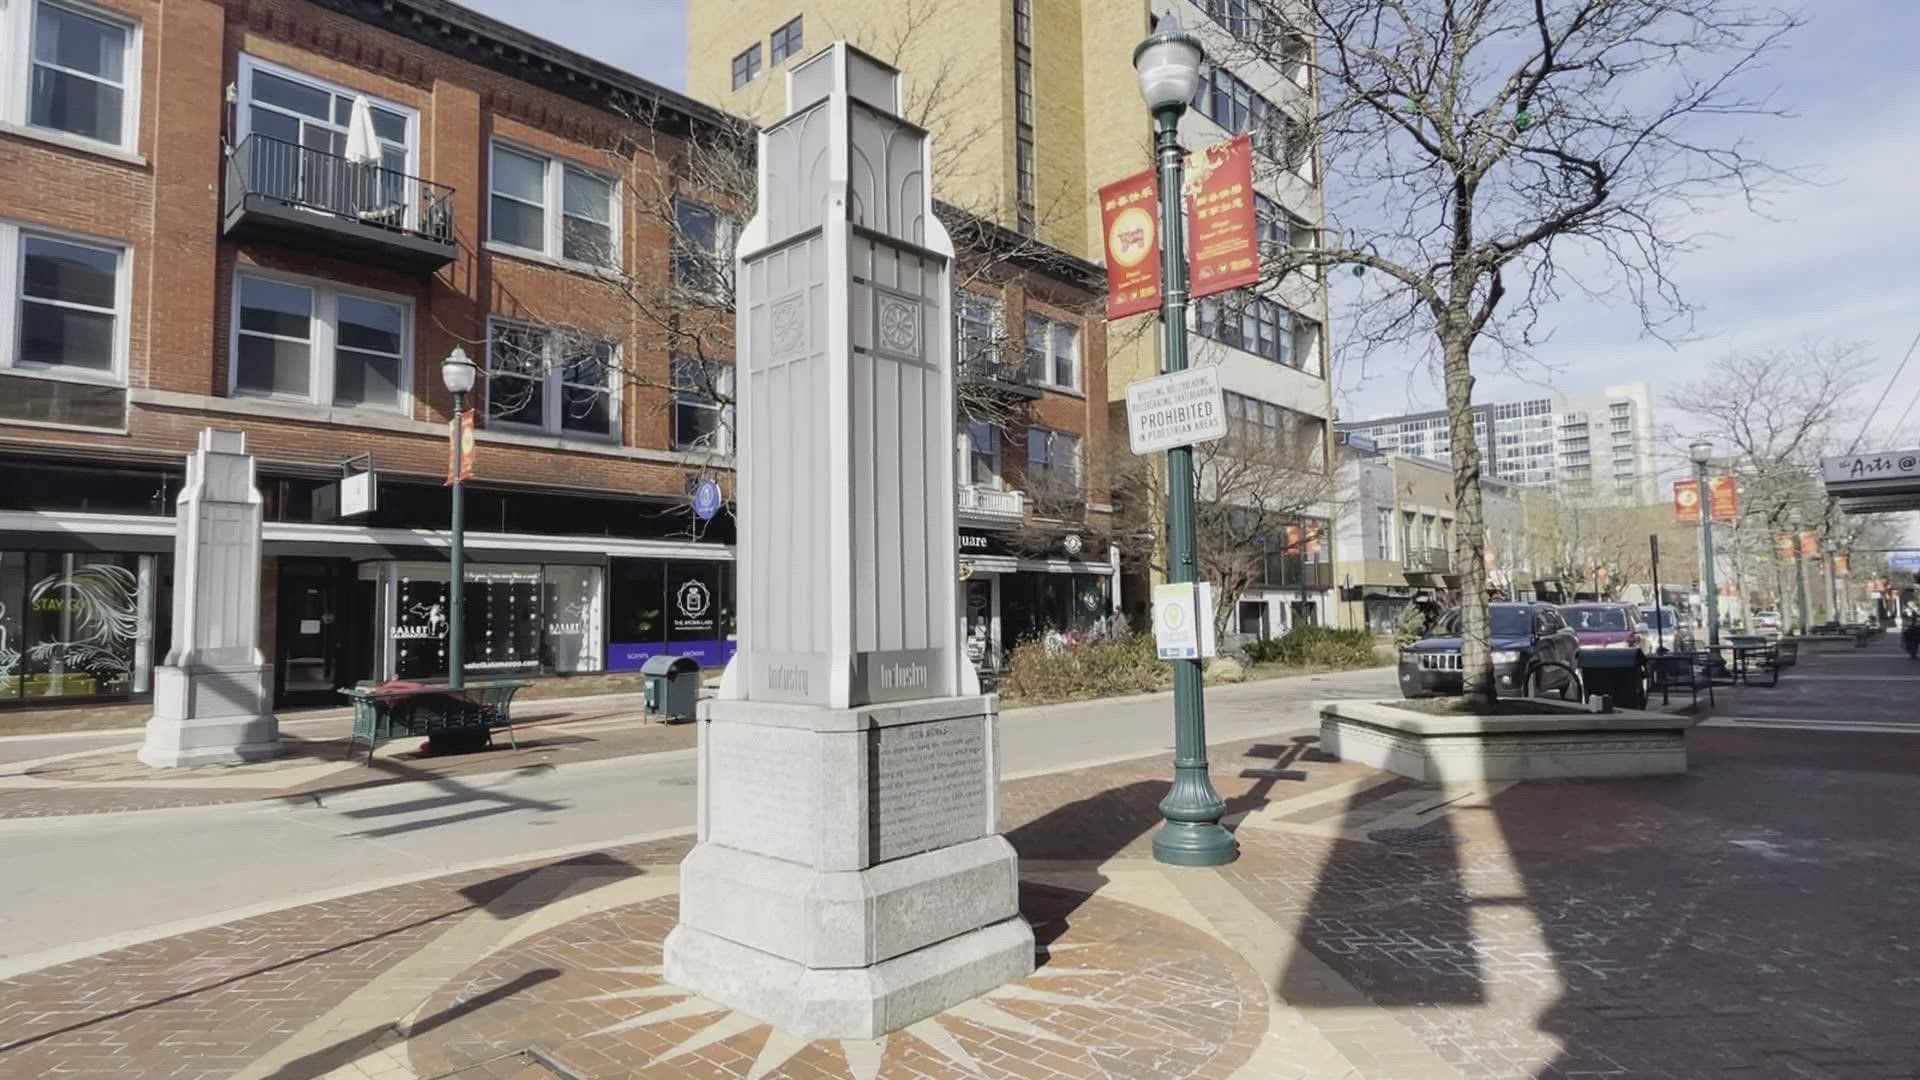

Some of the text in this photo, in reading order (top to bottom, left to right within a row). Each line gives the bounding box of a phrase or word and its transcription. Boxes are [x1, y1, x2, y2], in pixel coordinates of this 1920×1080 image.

[1140, 401, 1213, 430] PROHIBITED
[1850, 457, 1892, 478] Arts
[1898, 456, 1917, 471] @
[768, 663, 809, 696] Industry
[881, 662, 927, 689] Industry
